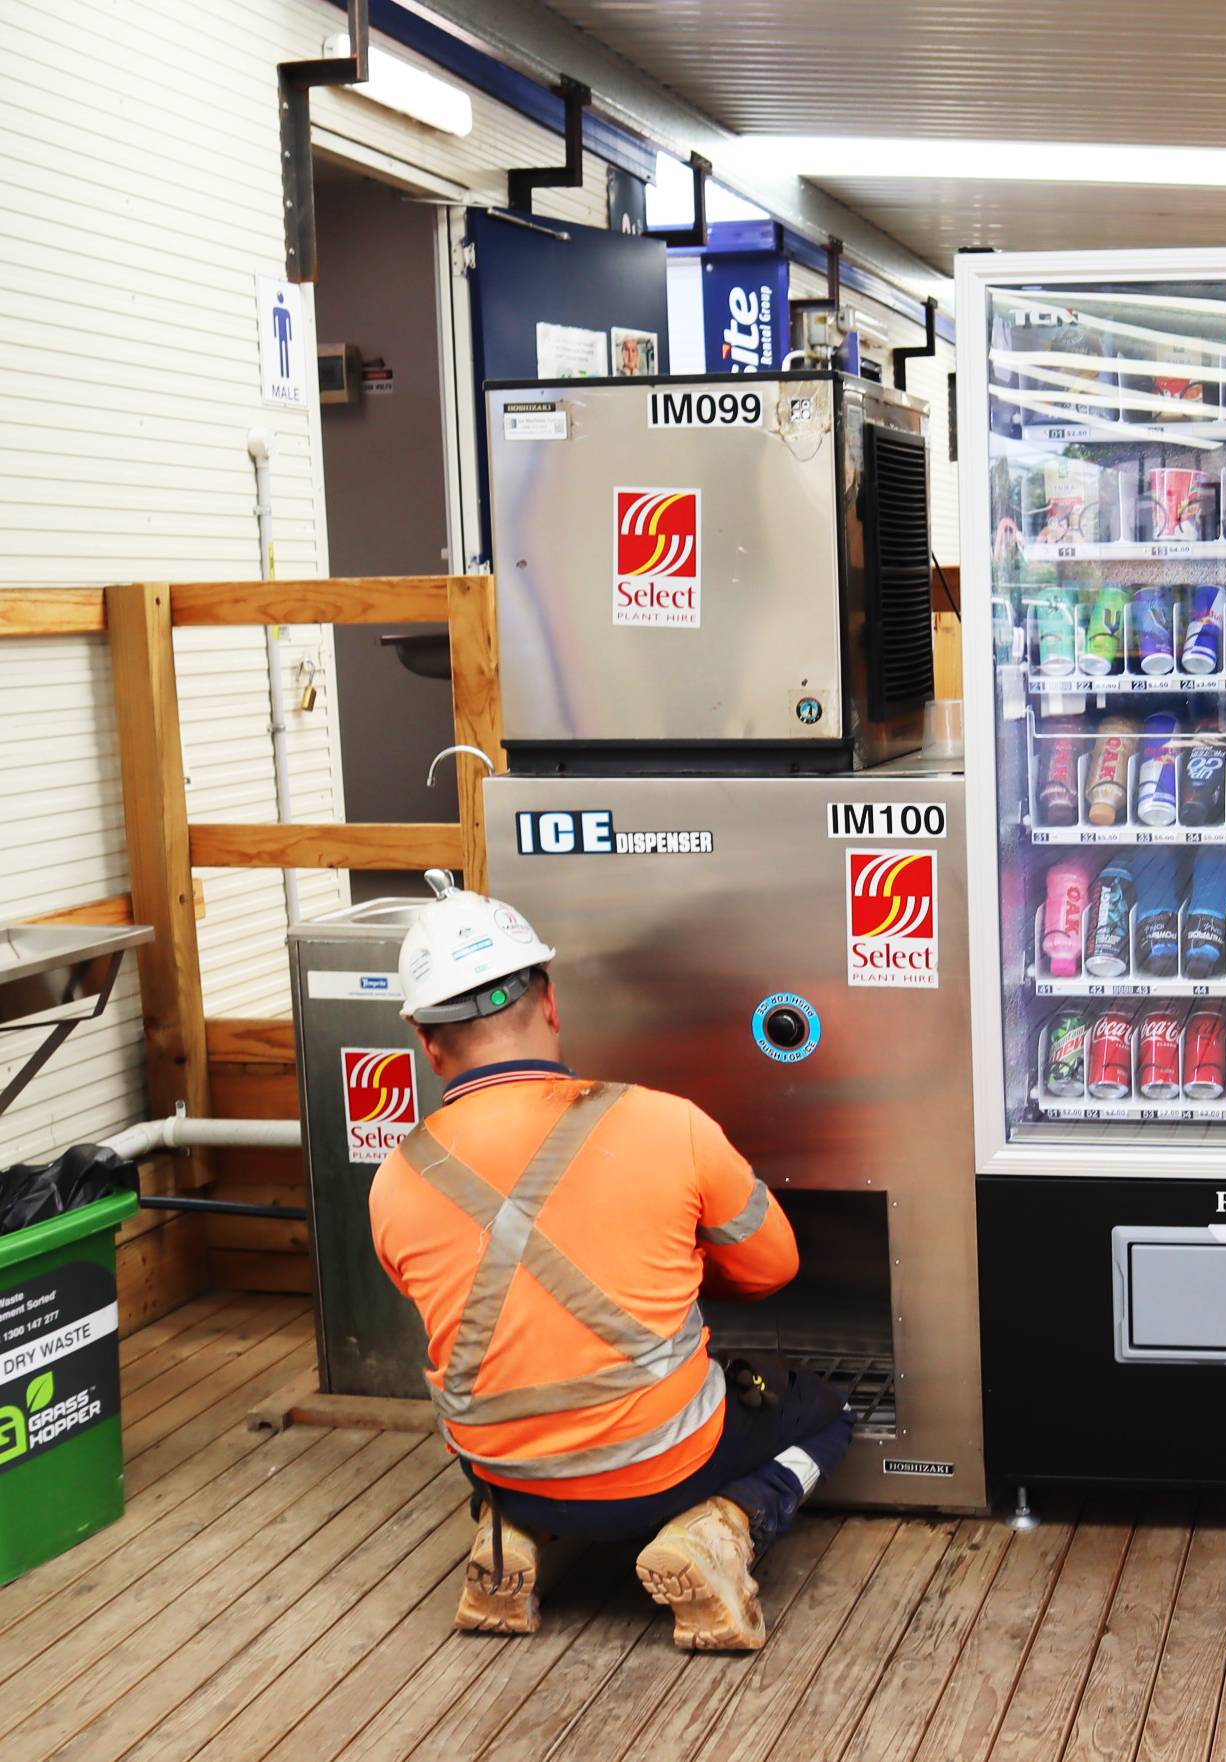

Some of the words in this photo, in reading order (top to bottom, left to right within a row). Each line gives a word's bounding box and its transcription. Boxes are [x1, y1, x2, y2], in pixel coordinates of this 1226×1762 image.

[758, 285, 773, 323] Group
[758, 324, 773, 366] Rental
[271, 384, 299, 401] MALE
[651, 392, 761, 425] IM099
[617, 580, 697, 609] Select
[616, 611, 660, 622] PLANT
[666, 613, 696, 624] HIRE
[518, 810, 613, 853] ICE
[616, 831, 713, 853] DISPENSER
[831, 804, 946, 836] IM100
[1065, 885, 1081, 937] OAK
[852, 942, 934, 969] Select
[852, 973, 897, 983] PLANT
[903, 974, 935, 983] HIRE
[756, 1000, 770, 1016] ICE
[771, 994, 790, 1005] FOR
[791, 997, 815, 1017] PUSH
[758, 1038, 781, 1061] PUSH
[782, 1051, 801, 1061] FOR
[802, 1040, 817, 1056] ICE
[351, 1126, 406, 1151] Selec
[352, 1151, 388, 1160] PLANT
[26, 1289, 57, 1311] Sorted
[3, 1324, 25, 1342] 1300
[26, 1316, 43, 1331] 147
[43, 1309, 60, 1325] 277
[3, 1348, 36, 1376] DRY
[39, 1322, 92, 1358] WASTE
[28, 1388, 90, 1432] GRASS
[29, 1399, 102, 1449] HOPPER
[888, 1462, 950, 1474] HOSHIZAKI
